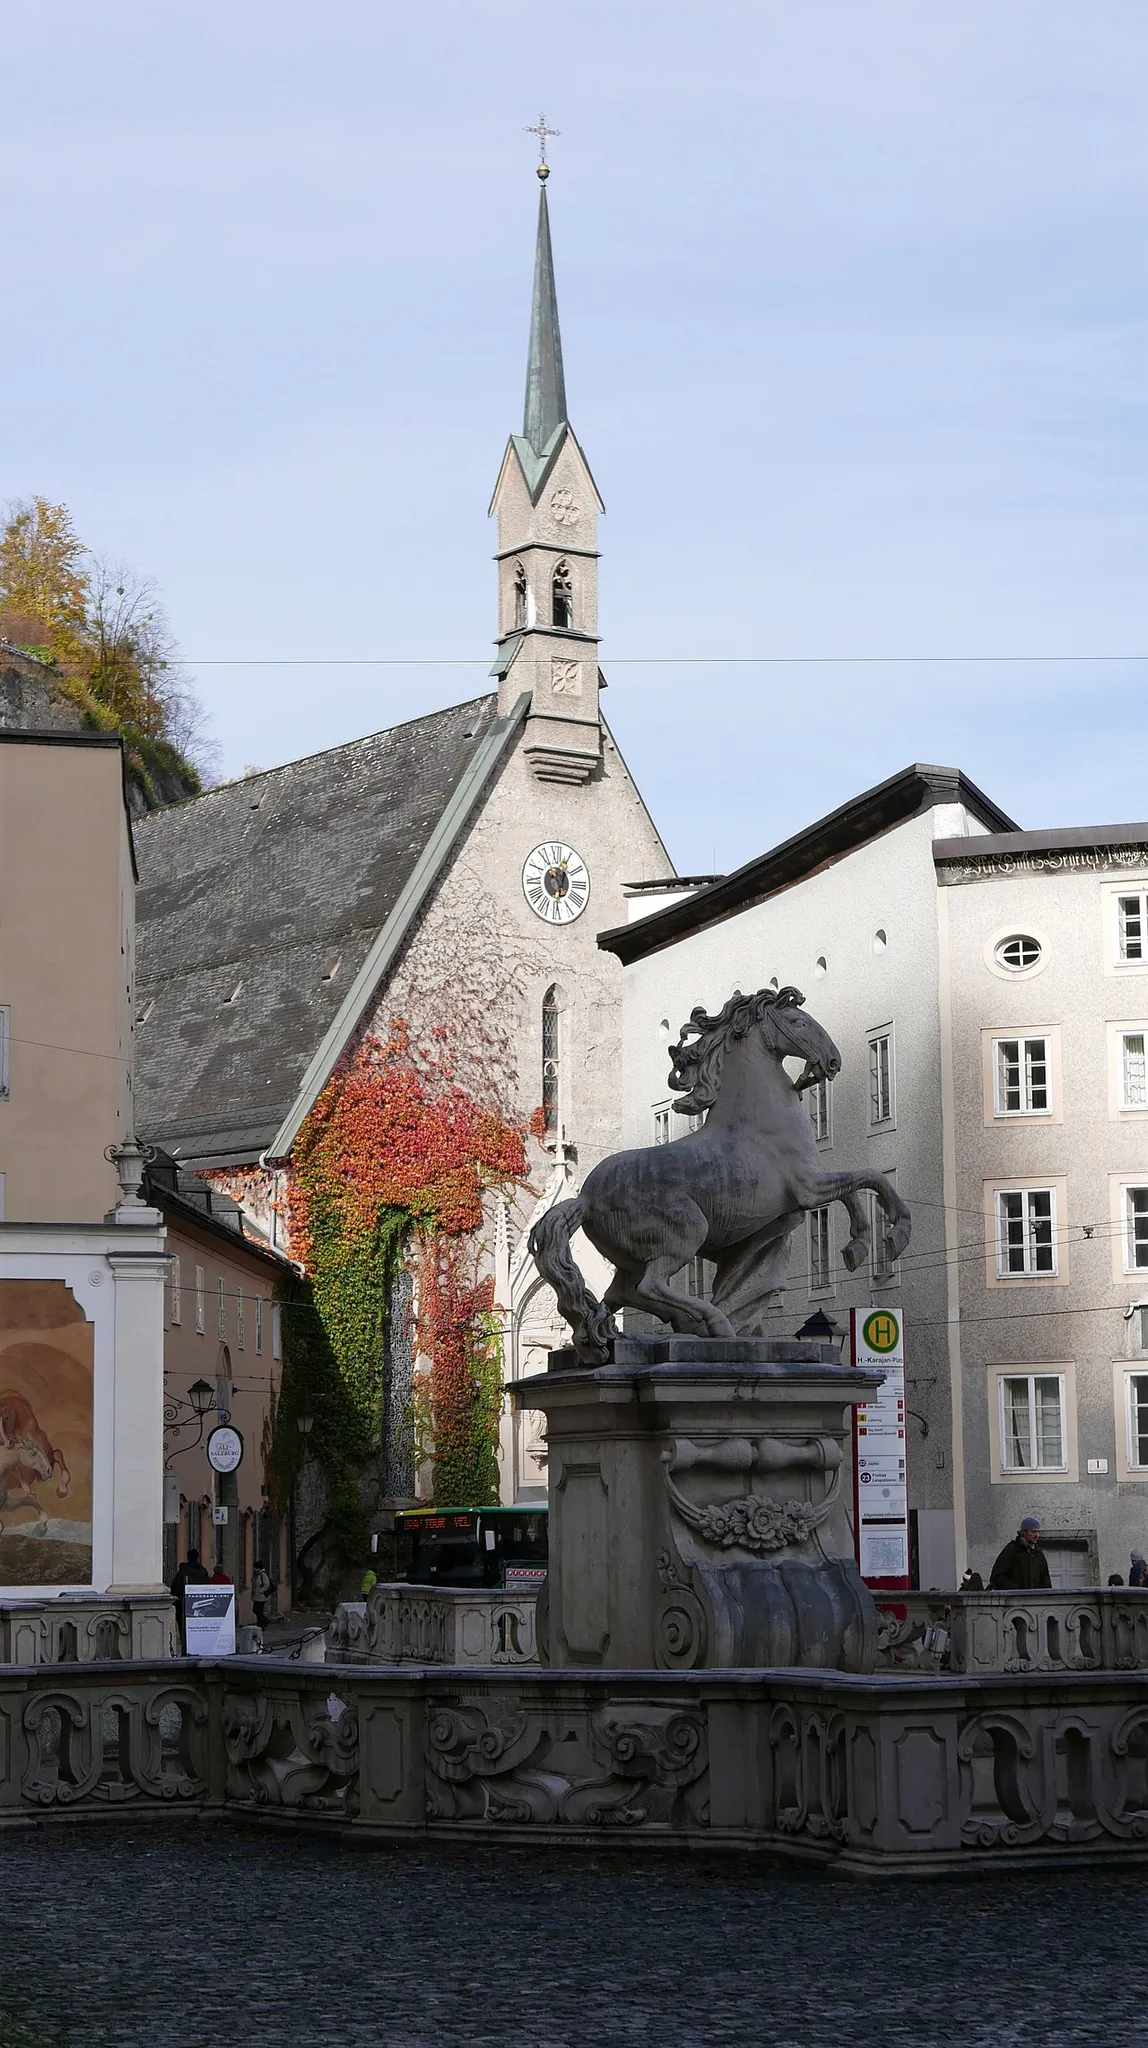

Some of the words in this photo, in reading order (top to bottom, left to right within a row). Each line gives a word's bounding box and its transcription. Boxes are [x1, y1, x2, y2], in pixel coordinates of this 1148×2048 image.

[550, 845, 562, 864] XII
[572, 881, 586, 890] III
[875, 1320, 891, 1344] H
